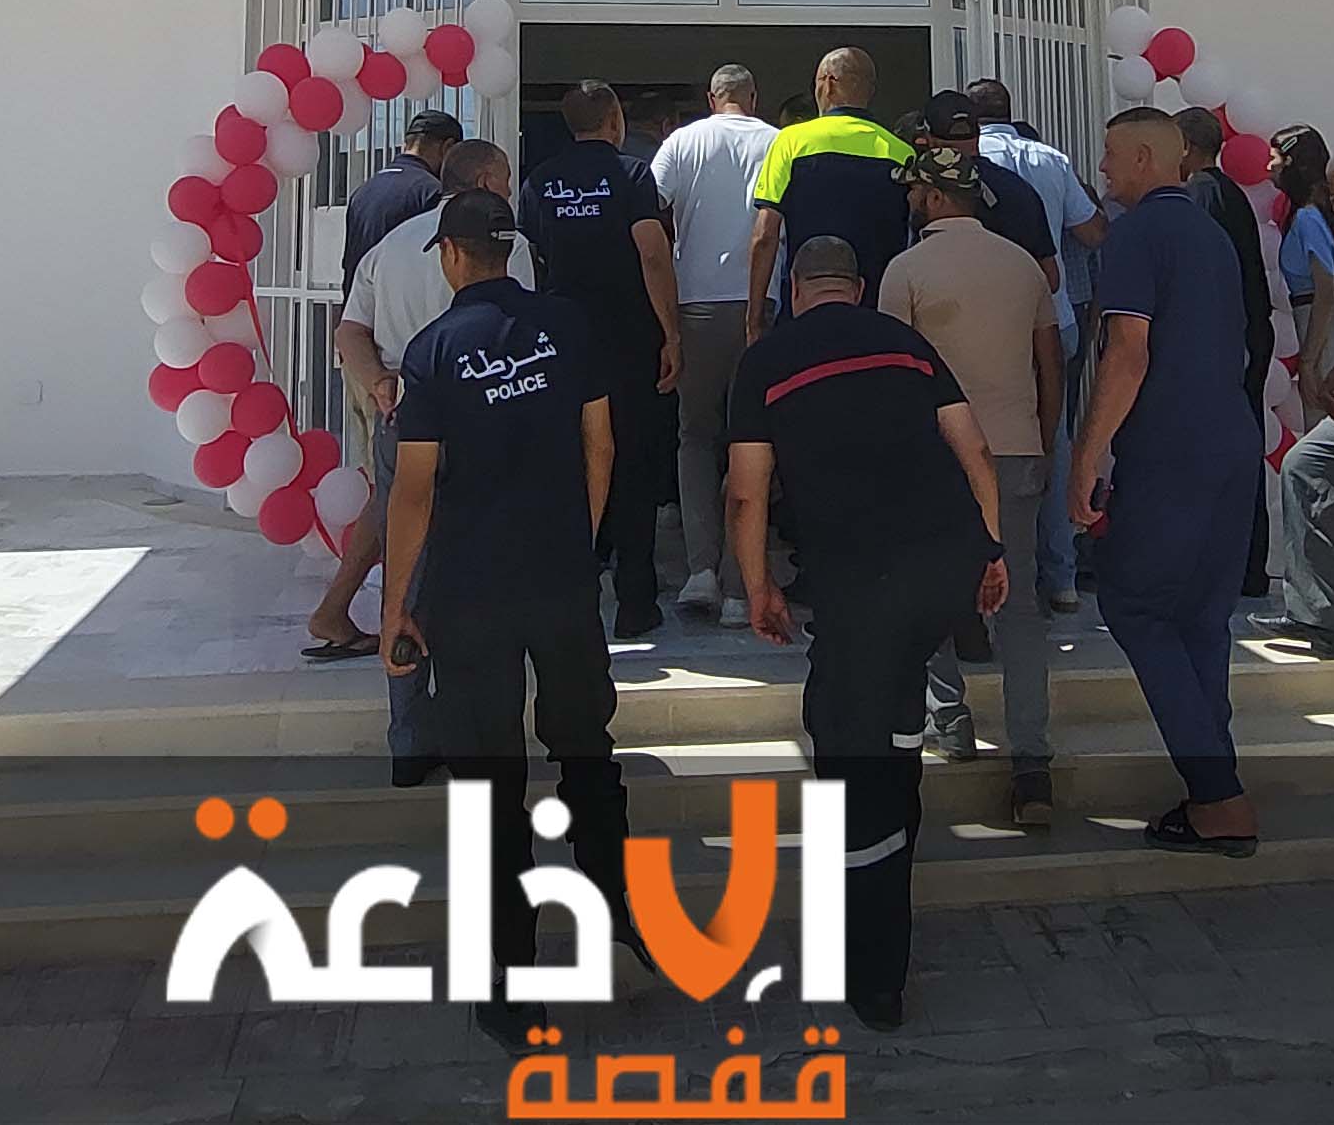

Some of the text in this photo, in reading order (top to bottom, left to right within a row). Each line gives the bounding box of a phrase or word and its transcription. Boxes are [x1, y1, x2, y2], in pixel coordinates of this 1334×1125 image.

[543, 177, 611, 204] شرطة
[556, 204, 601, 218] POLICE
[457, 331, 558, 380] شرطة
[485, 372, 548, 405] POLICE
